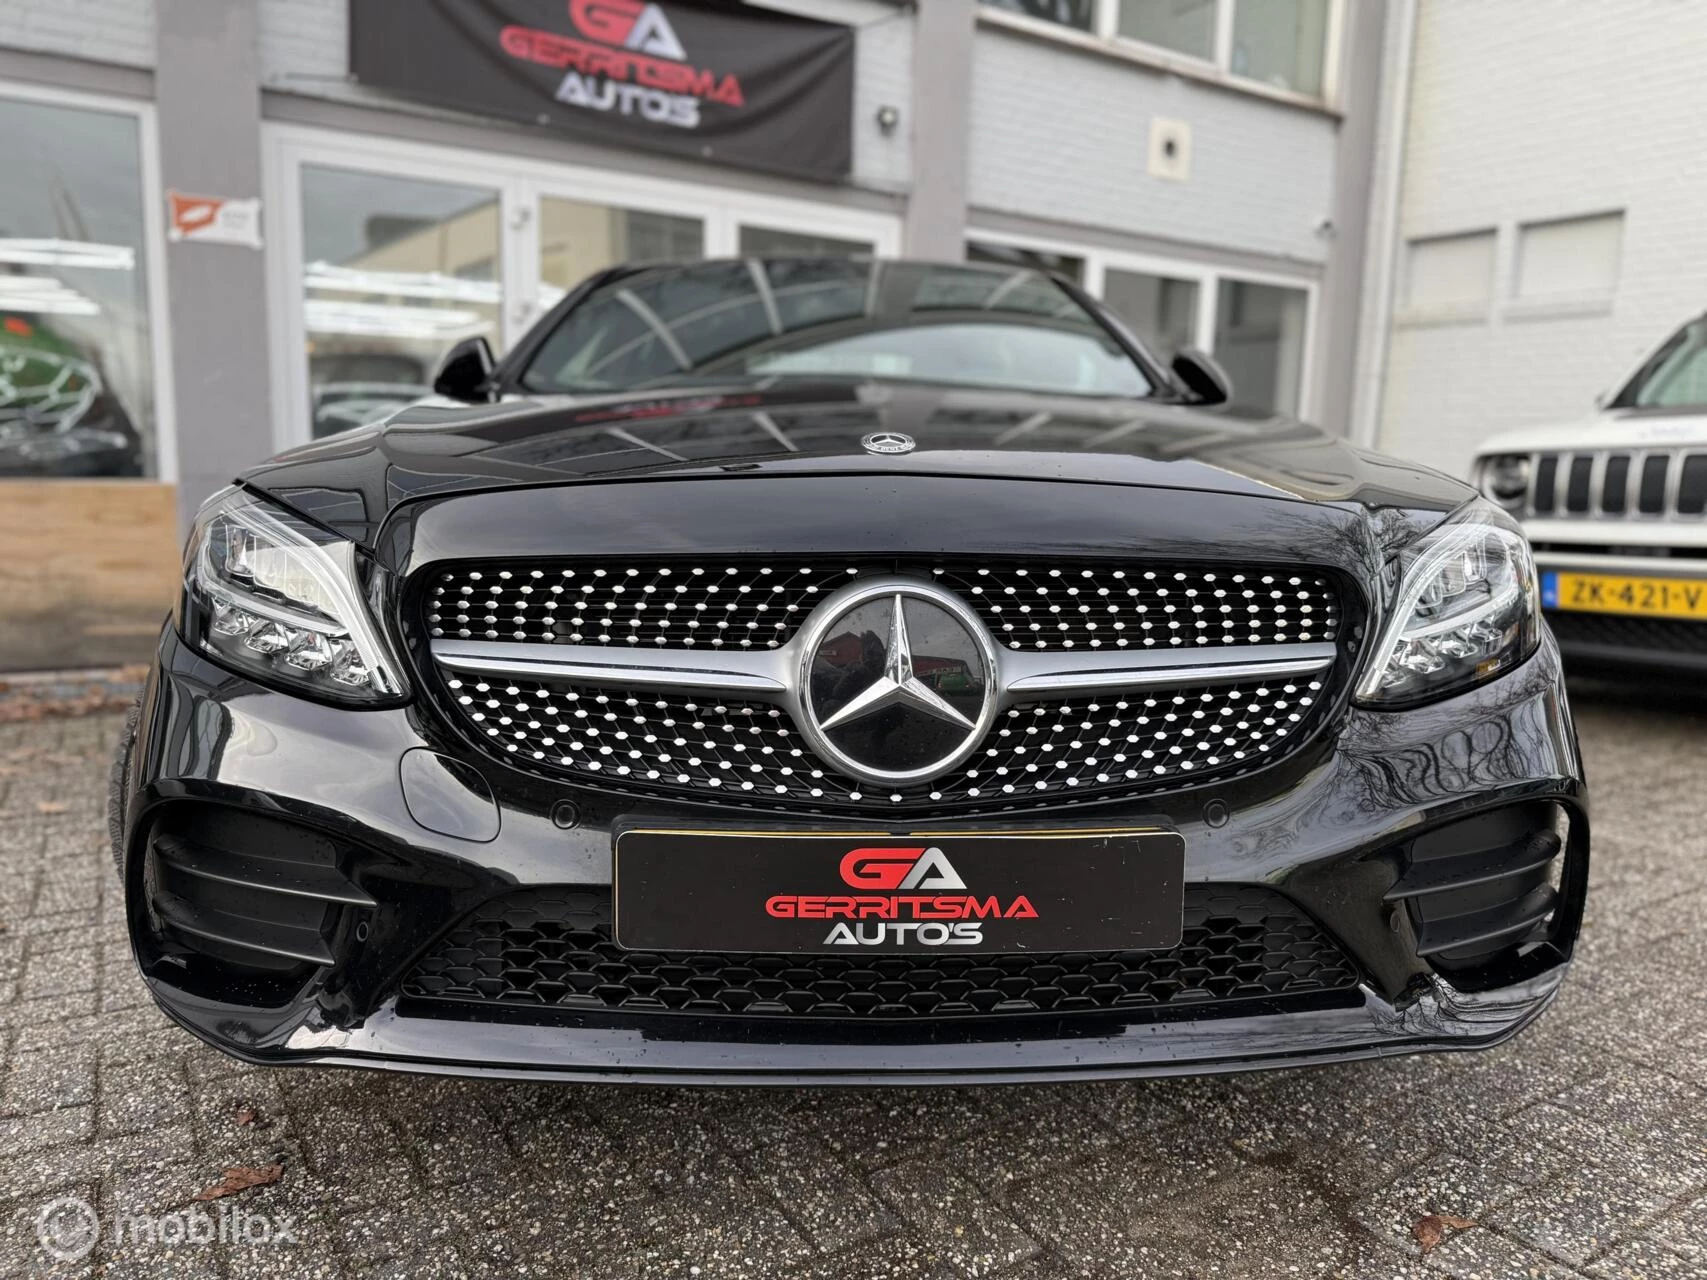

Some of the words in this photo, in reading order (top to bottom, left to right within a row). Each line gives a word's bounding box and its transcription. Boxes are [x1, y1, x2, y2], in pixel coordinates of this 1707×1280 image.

[569, 0, 687, 61] GA
[840, 847, 967, 889] GA
[765, 896, 1039, 919] GERRITSMA
[822, 922, 983, 946] AUTO'S
